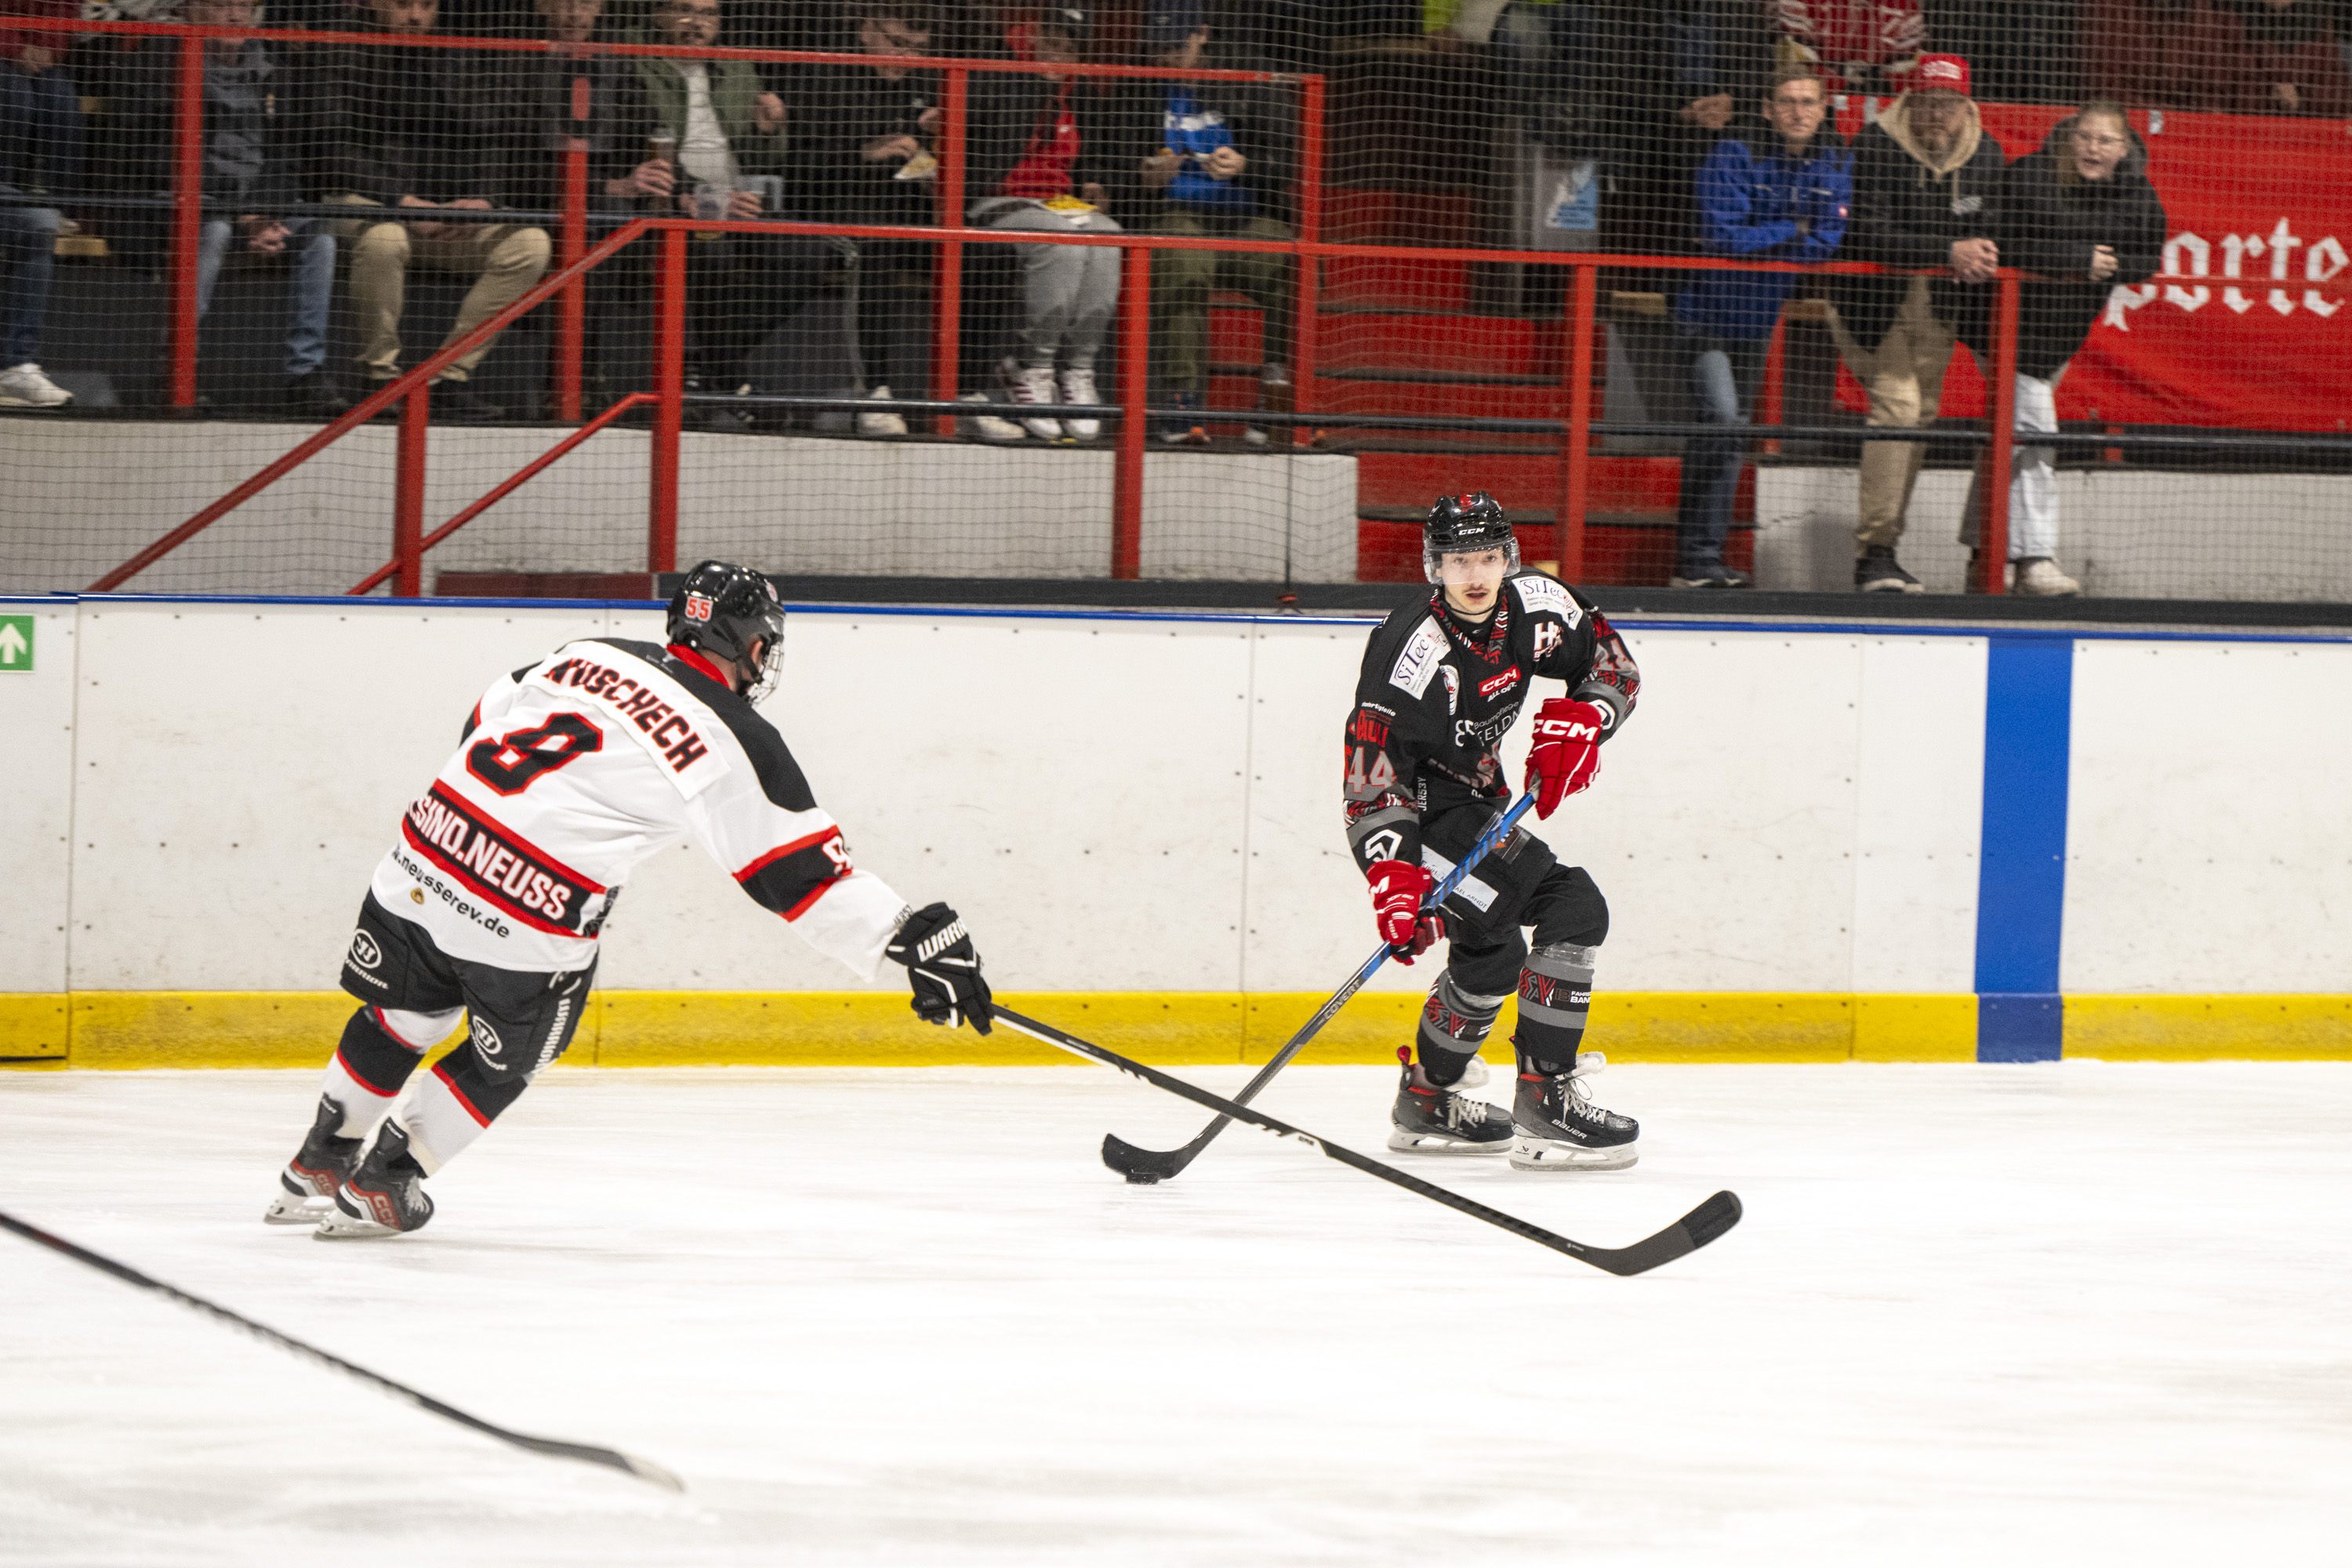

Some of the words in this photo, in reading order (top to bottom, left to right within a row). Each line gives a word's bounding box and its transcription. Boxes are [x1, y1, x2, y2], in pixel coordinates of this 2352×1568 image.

[1458, 527, 1485, 535] CCM
[685, 597, 713, 621] 55
[1481, 669, 1517, 692] CCM
[1474, 702, 1519, 730] Baumpflege
[1348, 746, 1398, 794] 44
[1323, 978, 1360, 1020] COVERT
[1552, 1118, 1588, 1140] BAUER
